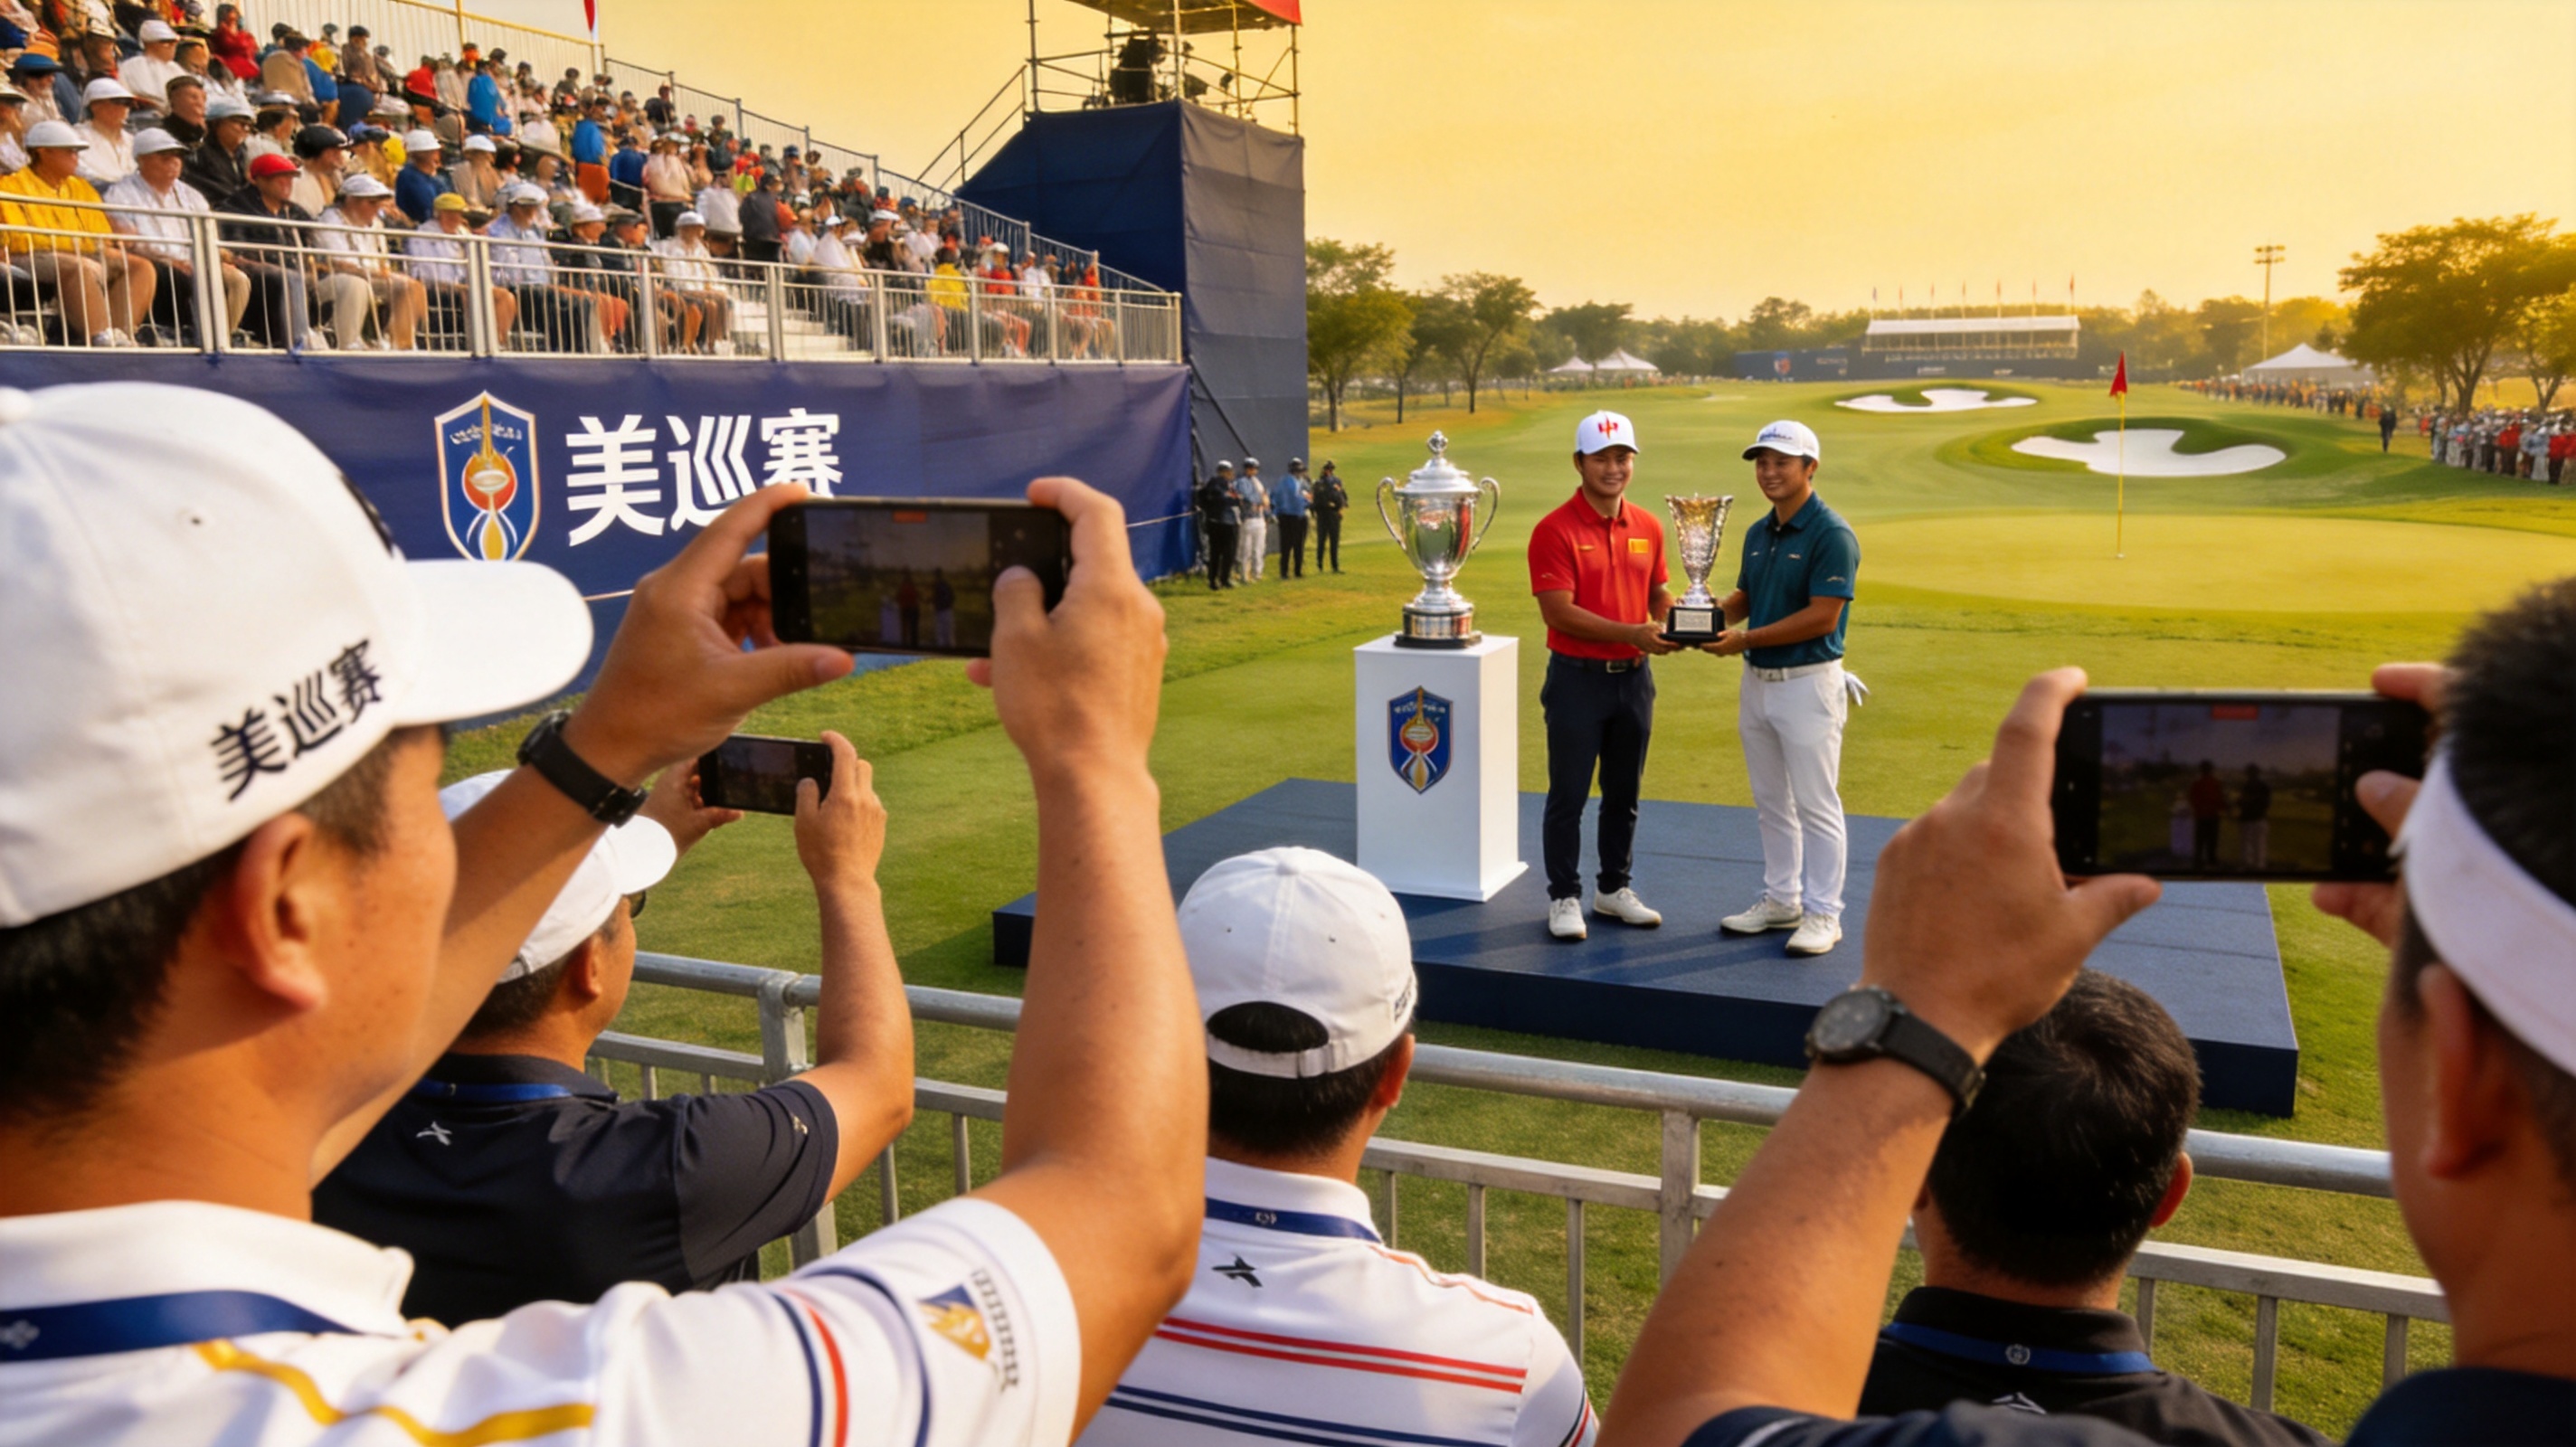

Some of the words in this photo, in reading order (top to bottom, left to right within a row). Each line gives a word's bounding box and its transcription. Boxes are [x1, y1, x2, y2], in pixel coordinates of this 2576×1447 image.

[566, 408, 843, 546] 美巡赛
[211, 638, 382, 800] 美巡赛
